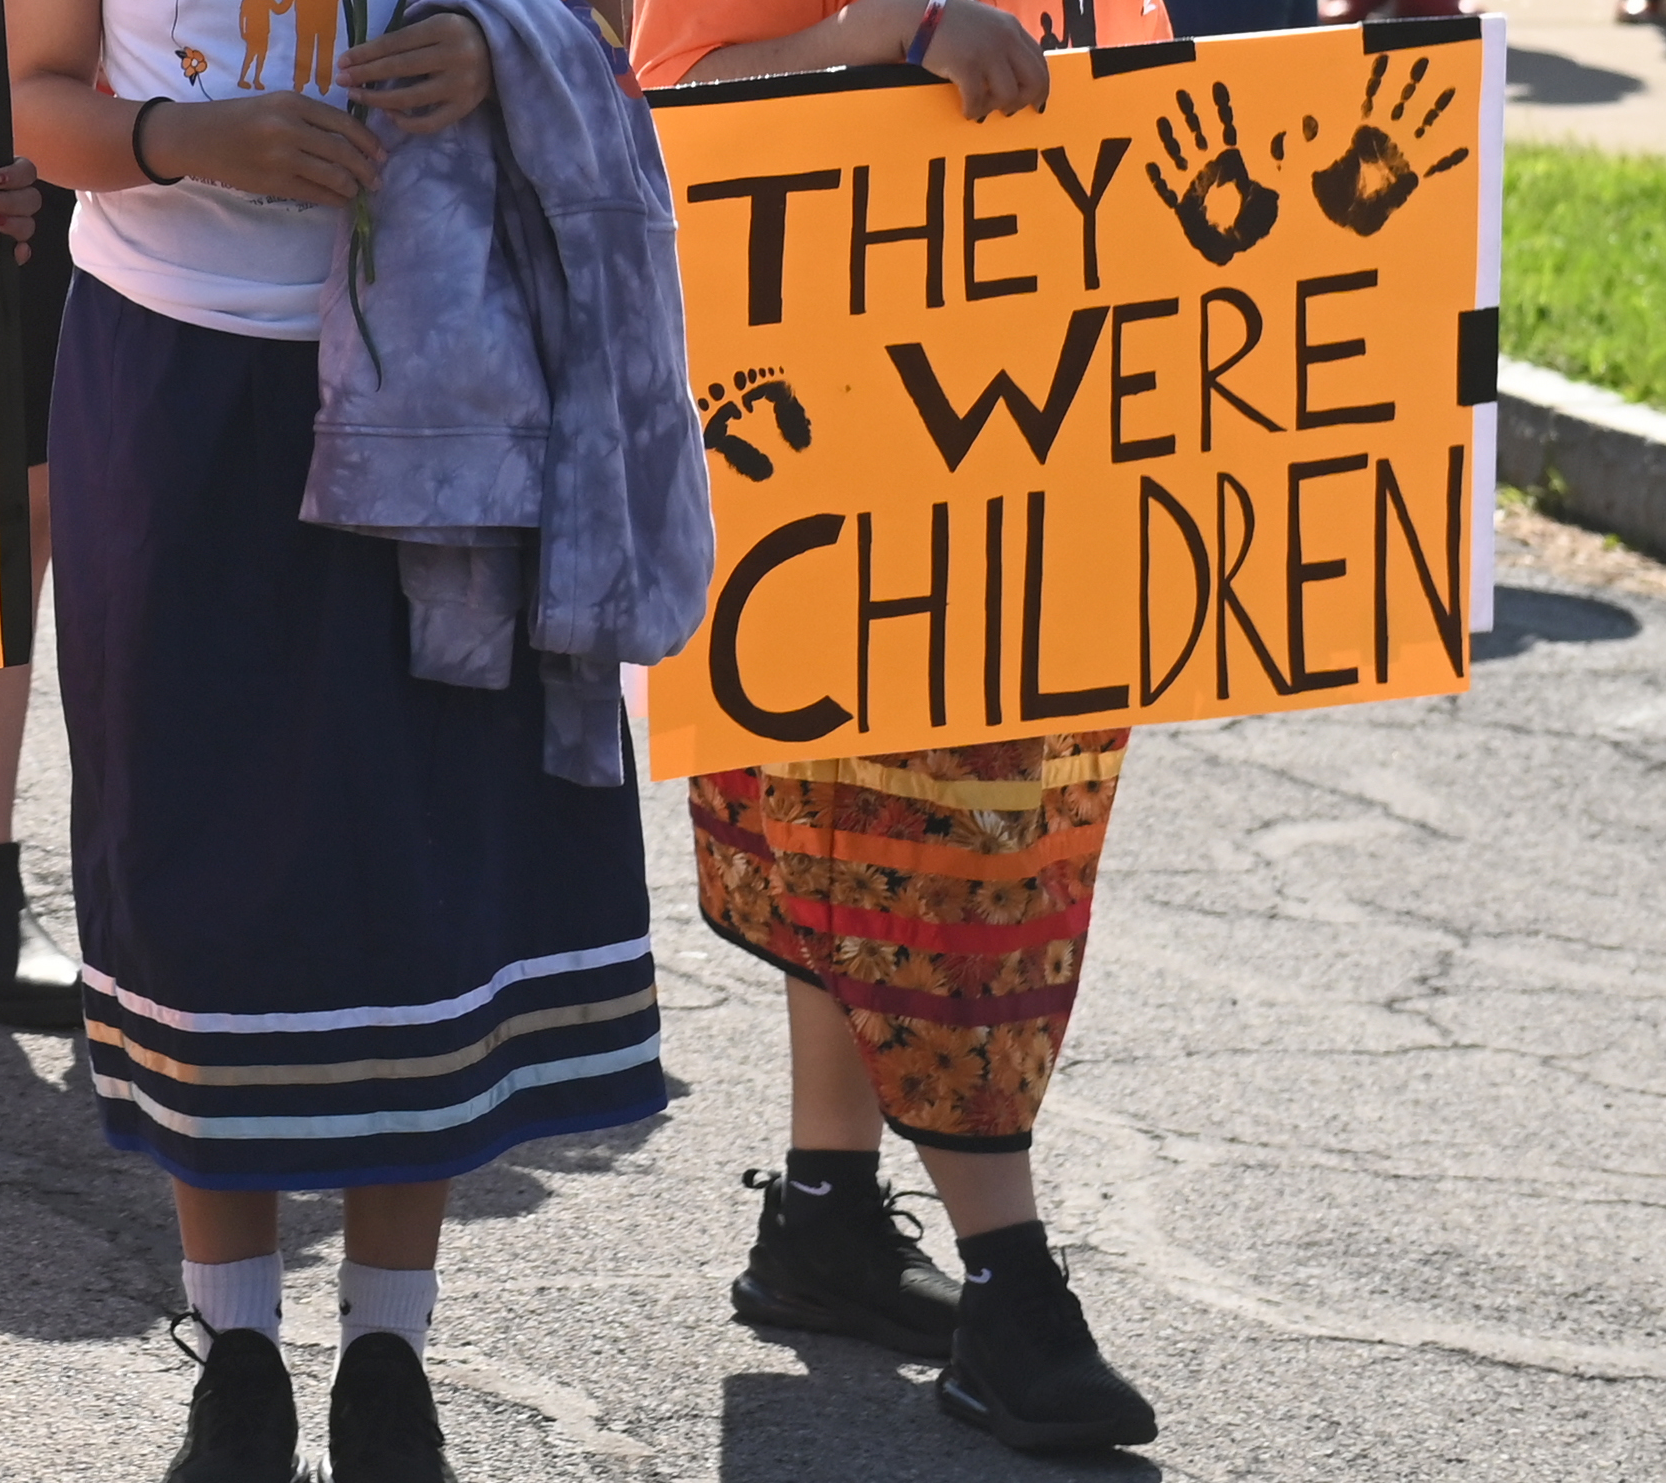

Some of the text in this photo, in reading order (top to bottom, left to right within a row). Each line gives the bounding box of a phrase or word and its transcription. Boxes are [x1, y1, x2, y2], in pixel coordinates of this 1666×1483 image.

[686, 137, 1133, 327] THEY
[884, 268, 1397, 474] WERE
[708, 444, 1466, 744] CHILDREN
